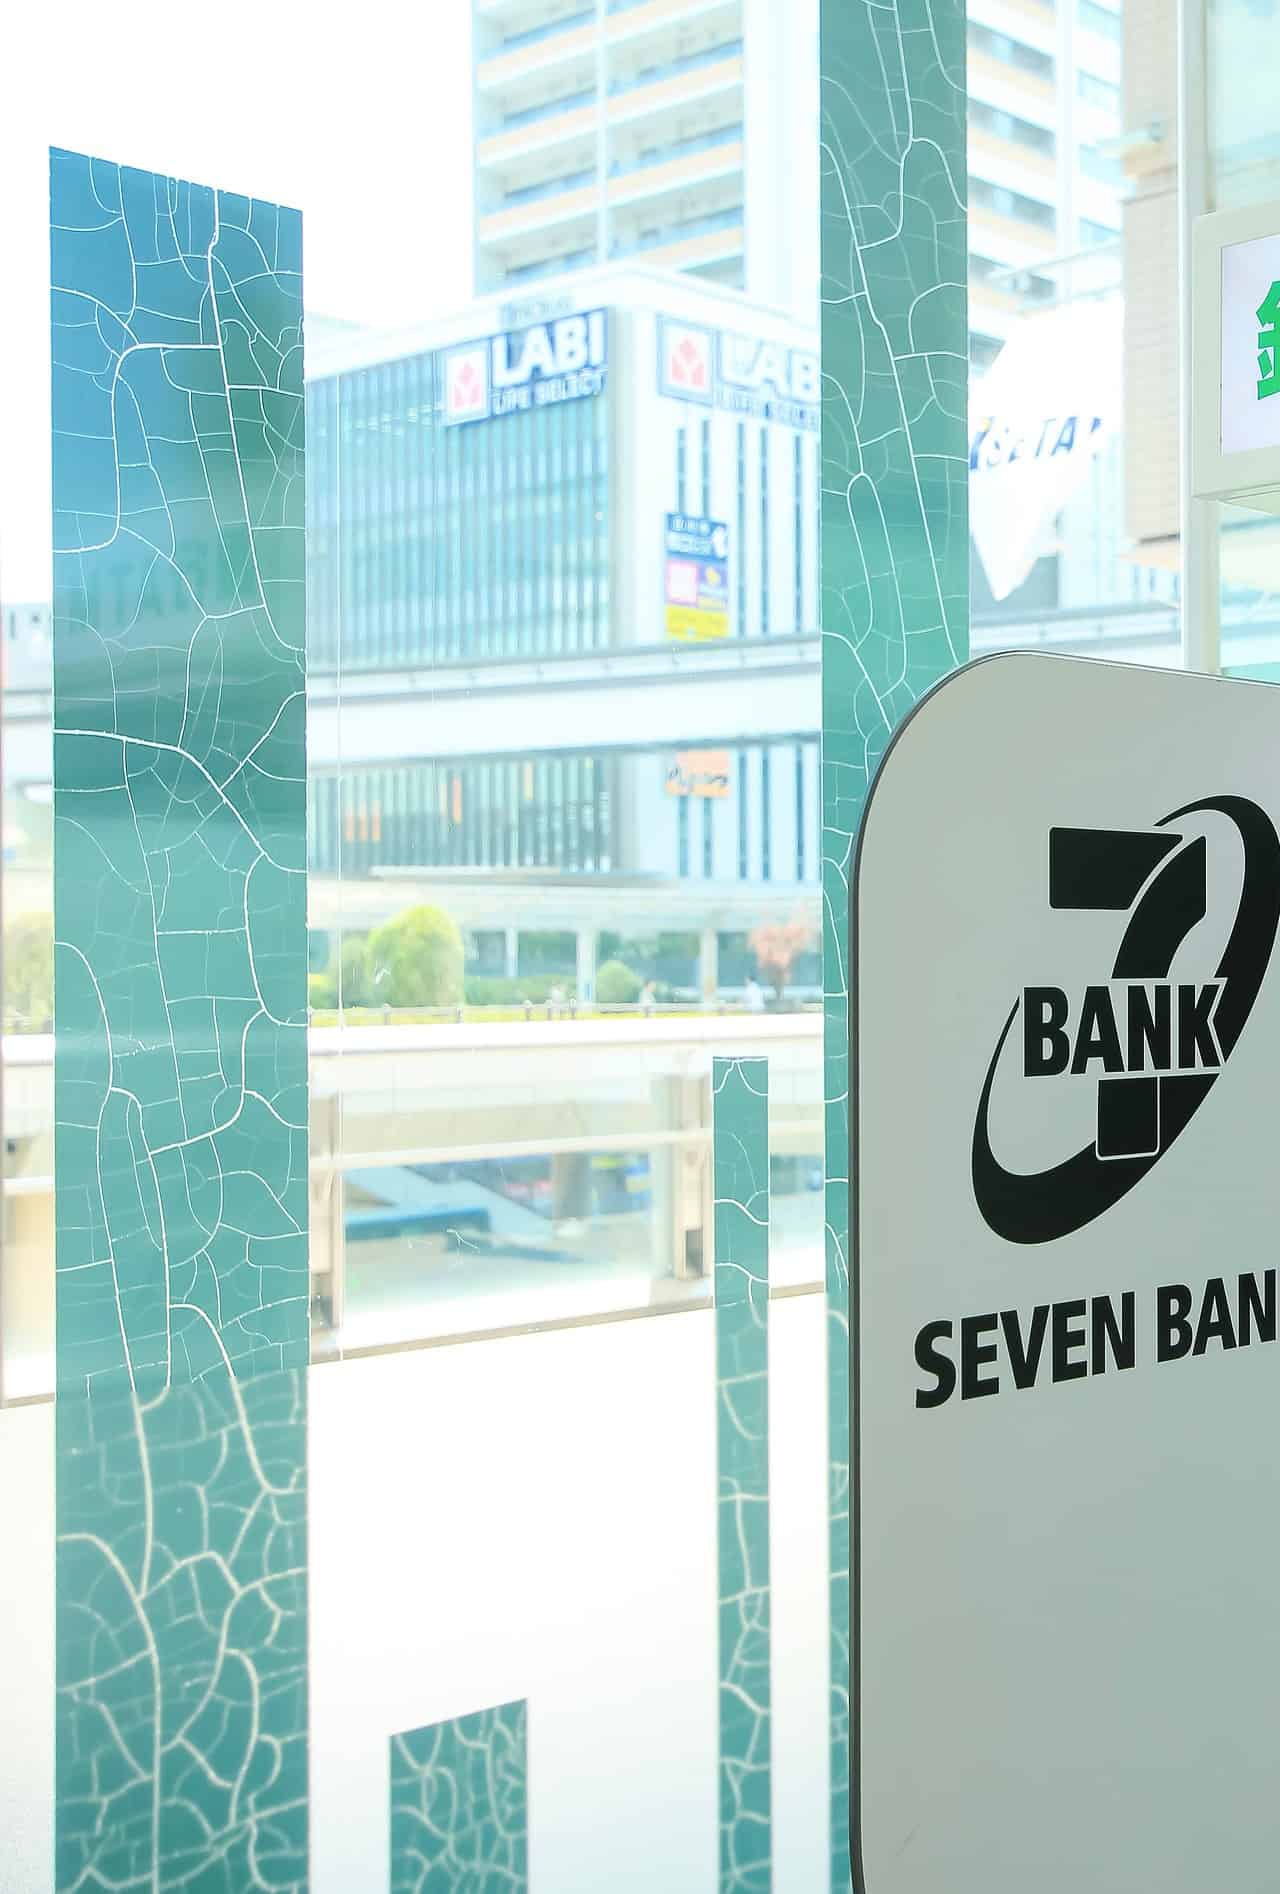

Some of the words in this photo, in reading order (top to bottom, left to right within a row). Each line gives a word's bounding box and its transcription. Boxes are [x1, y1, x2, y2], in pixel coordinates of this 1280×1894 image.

[492, 312, 606, 388] LABI
[721, 332, 821, 403] LAB
[1022, 983, 1222, 1077] BANK
[914, 1291, 1135, 1409] SEVEN
